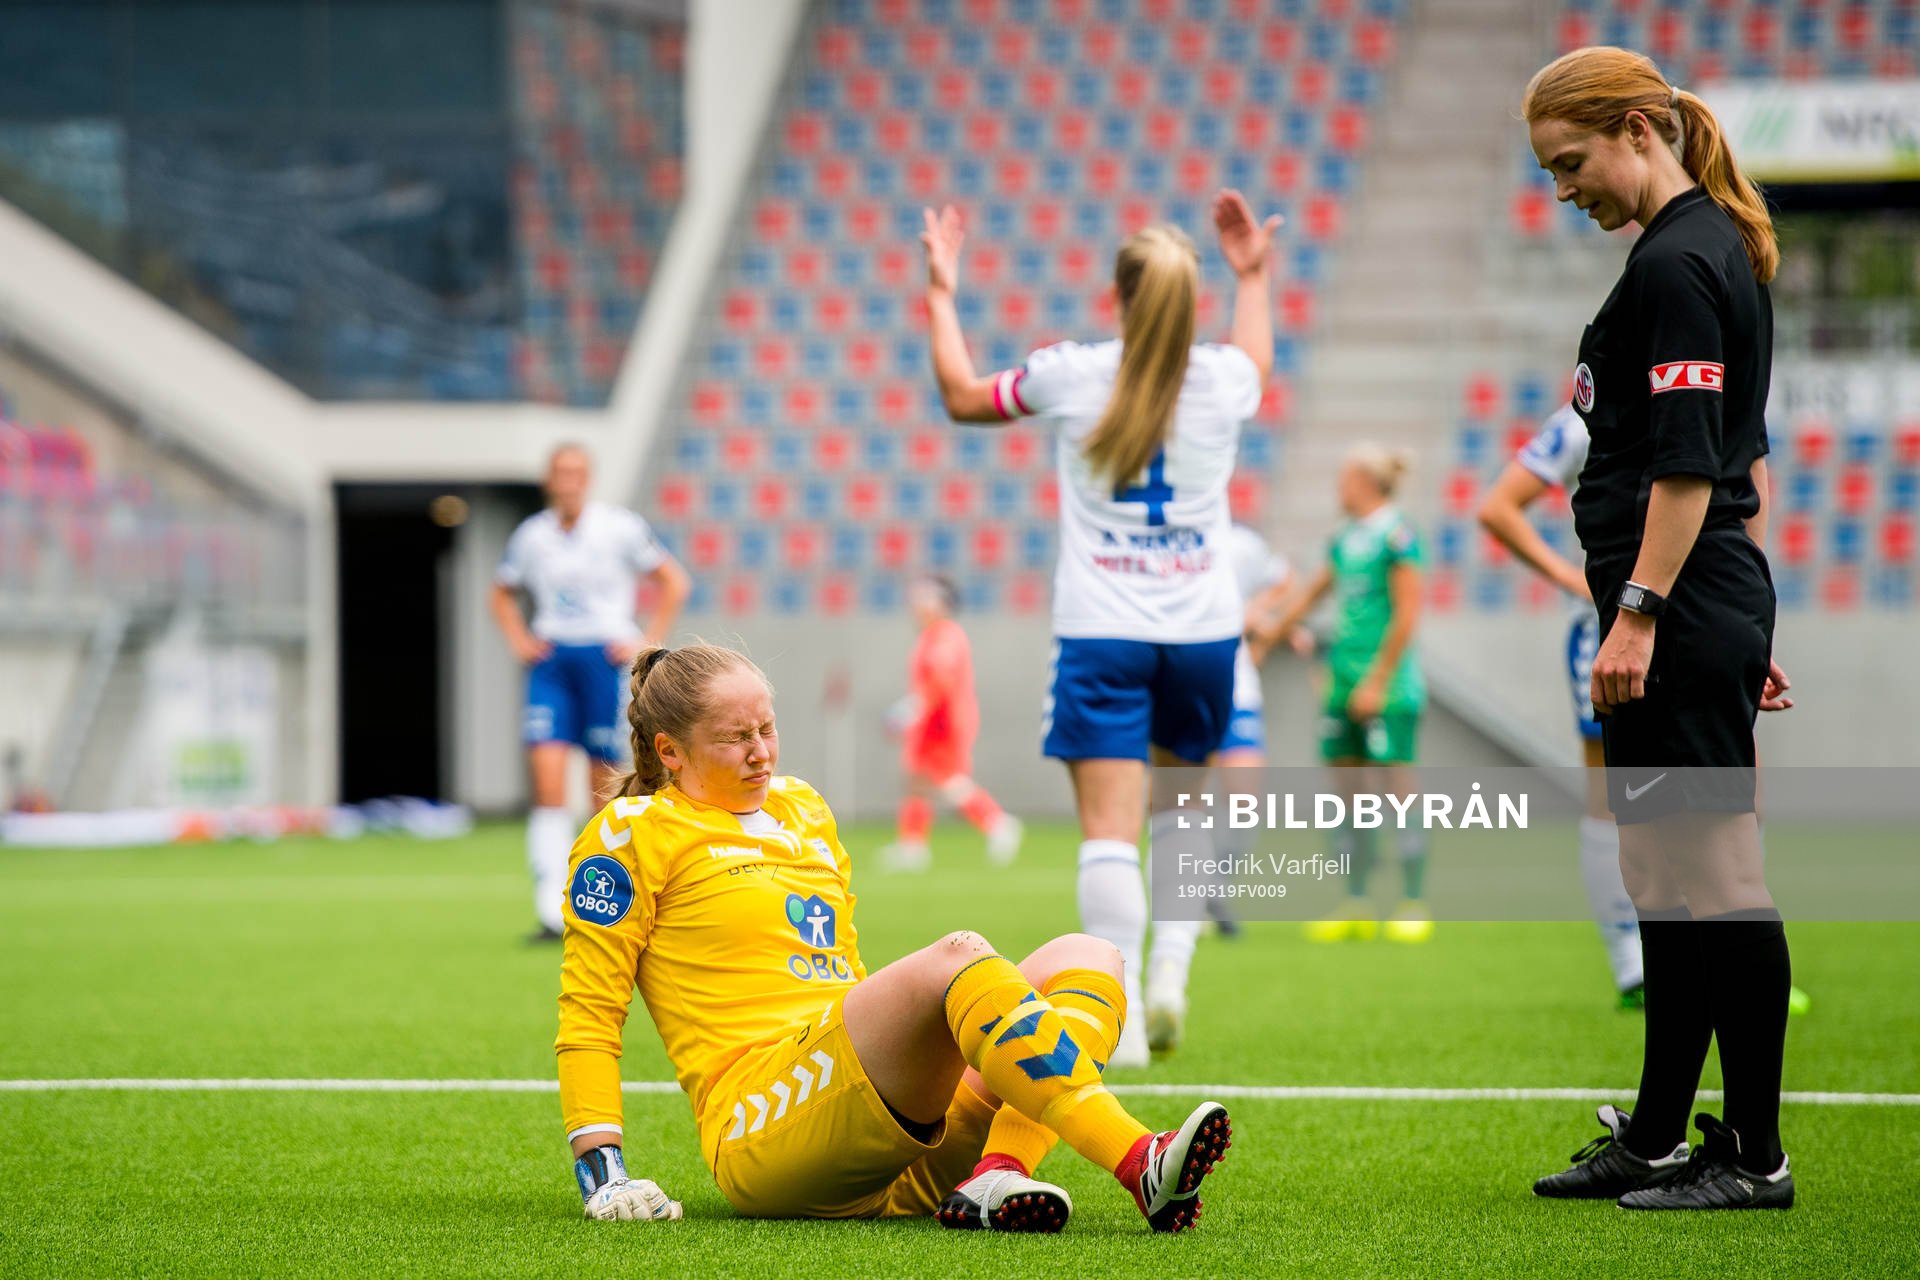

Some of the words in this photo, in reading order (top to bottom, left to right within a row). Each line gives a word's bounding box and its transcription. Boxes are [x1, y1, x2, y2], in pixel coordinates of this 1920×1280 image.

[1650, 364, 1722, 390] VG
[575, 893, 619, 916] OBOS
[788, 953, 857, 982] OBO
